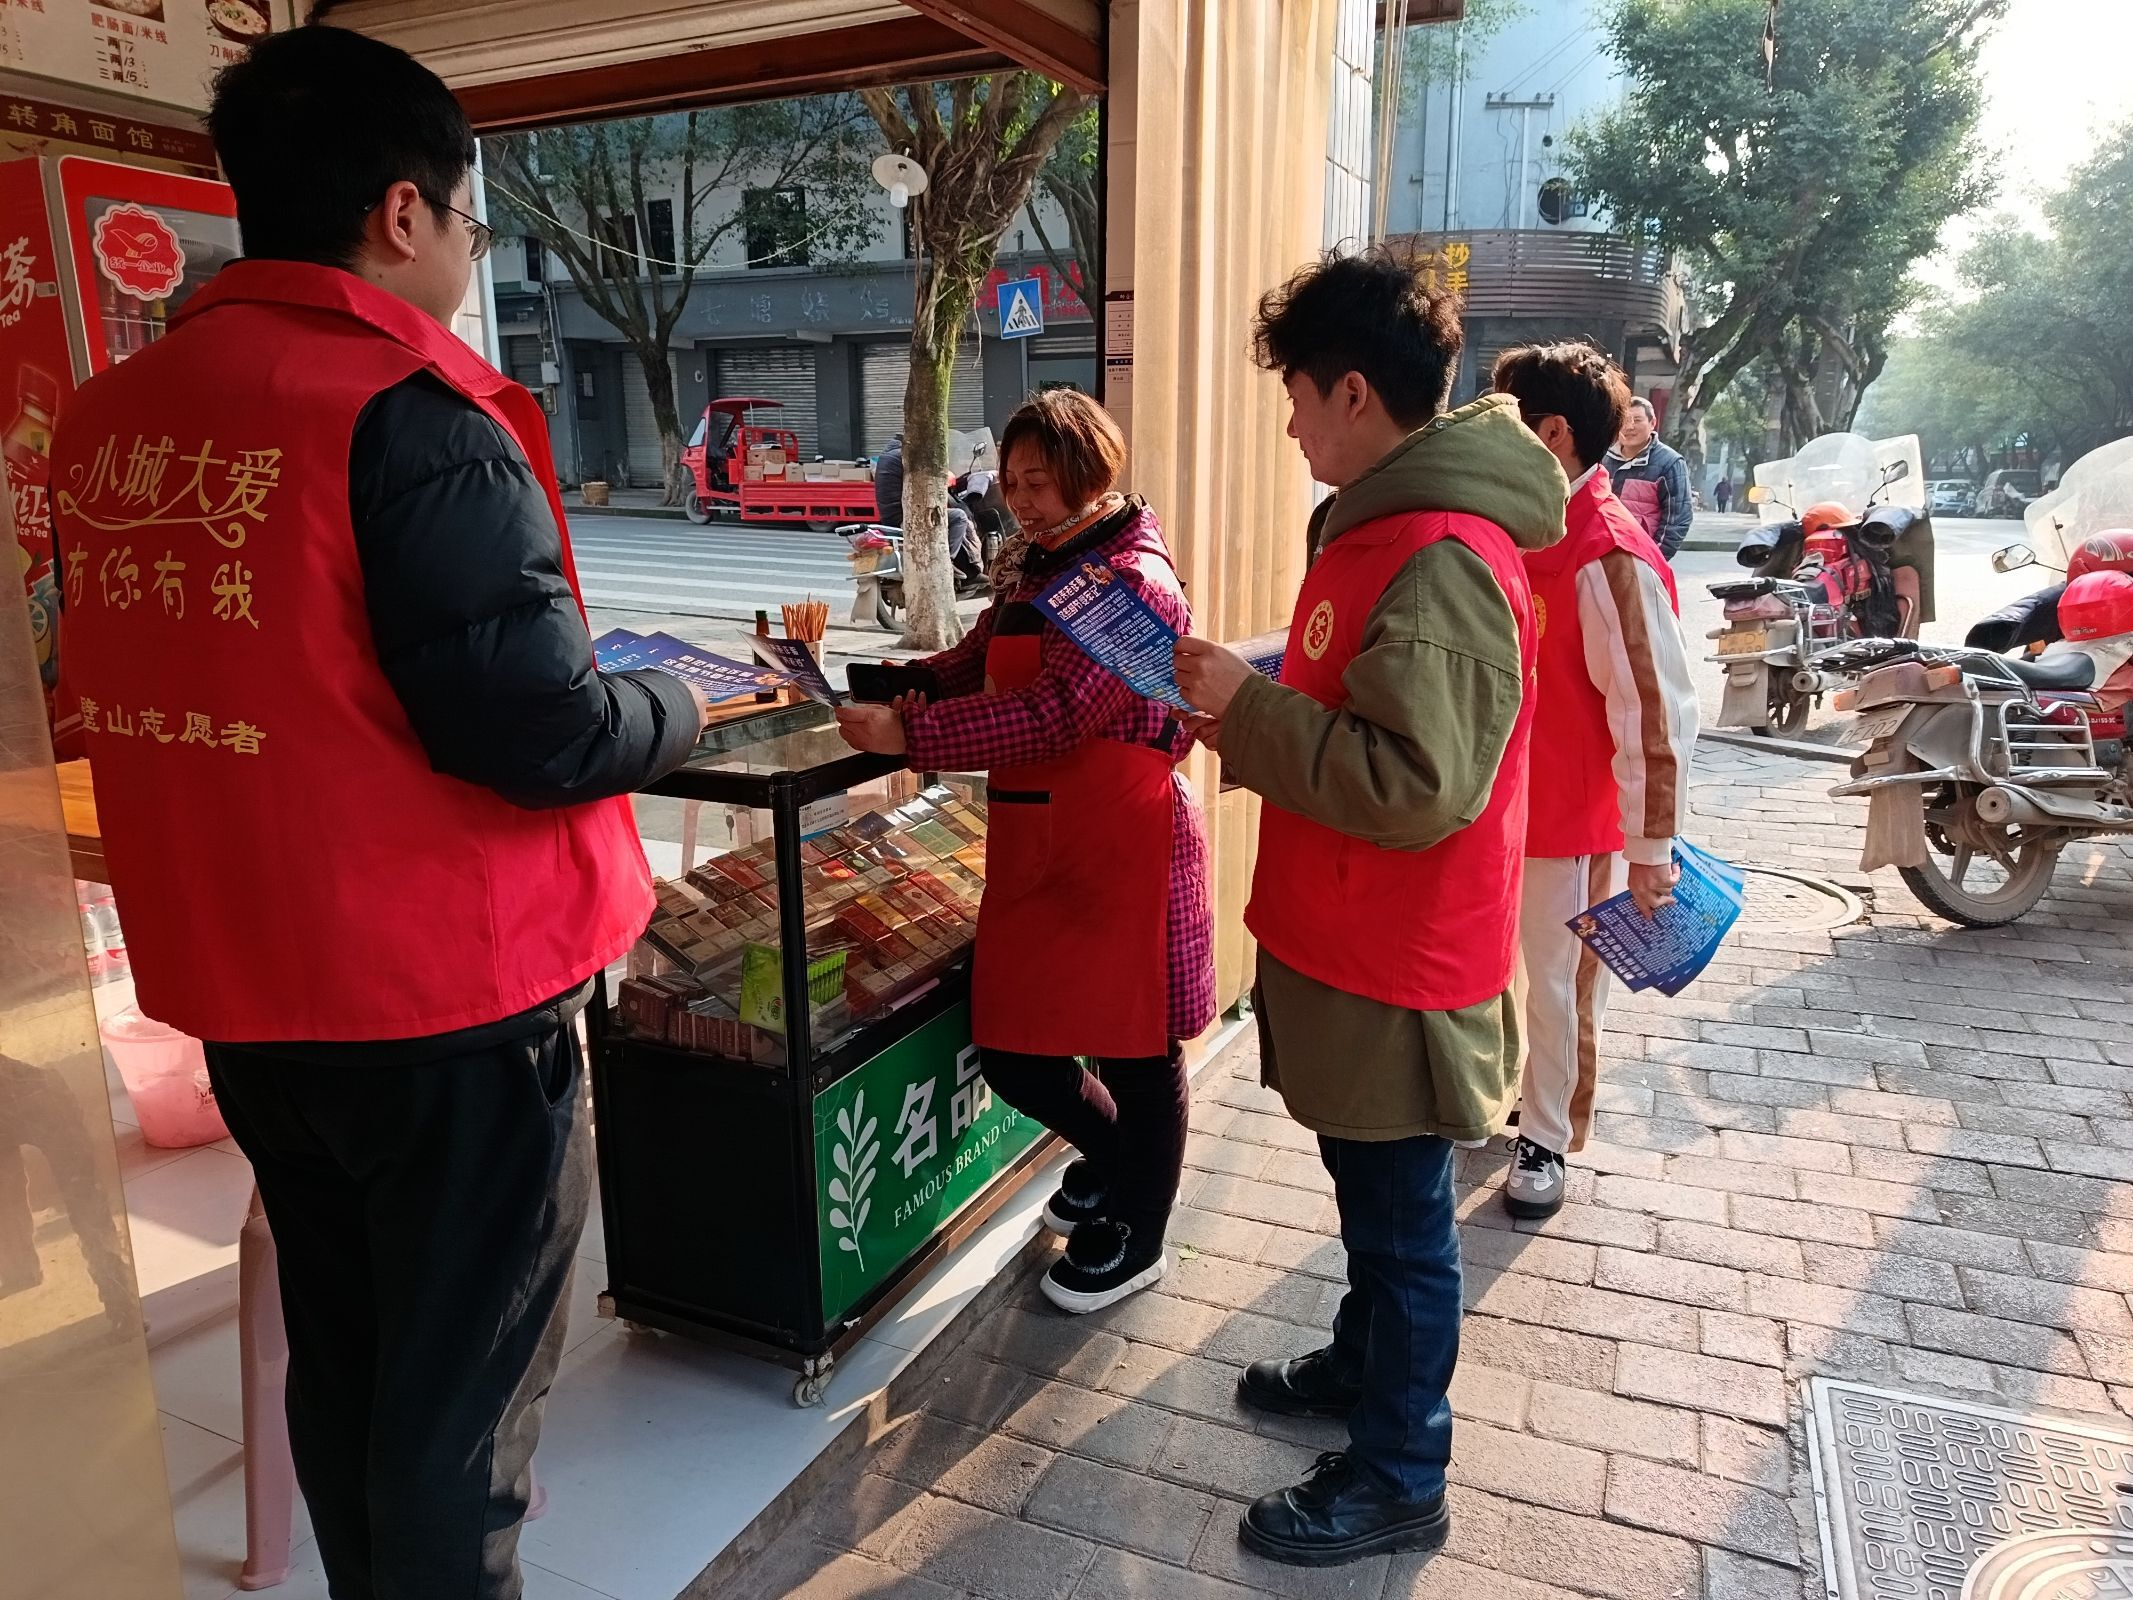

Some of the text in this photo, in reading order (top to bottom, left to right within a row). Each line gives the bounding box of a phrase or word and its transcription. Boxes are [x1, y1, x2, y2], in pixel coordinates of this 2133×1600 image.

[90, 12, 168, 45] 肥肠面/米线
[96, 50, 122, 66] 二两
[99, 67, 124, 83] 三两
[7, 103, 154, 150] 转角面馆
[0, 236, 36, 311] 茶
[1444, 242, 1470, 296] 抄手
[0, 309, 21, 329] Tea
[70, 434, 284, 523] 小城大爱
[32, 526, 48, 538] Tea
[67, 542, 260, 631] 有你有我
[890, 1042, 993, 1180] 名品
[894, 1108, 1019, 1229] FAMOUS BRAND OF
